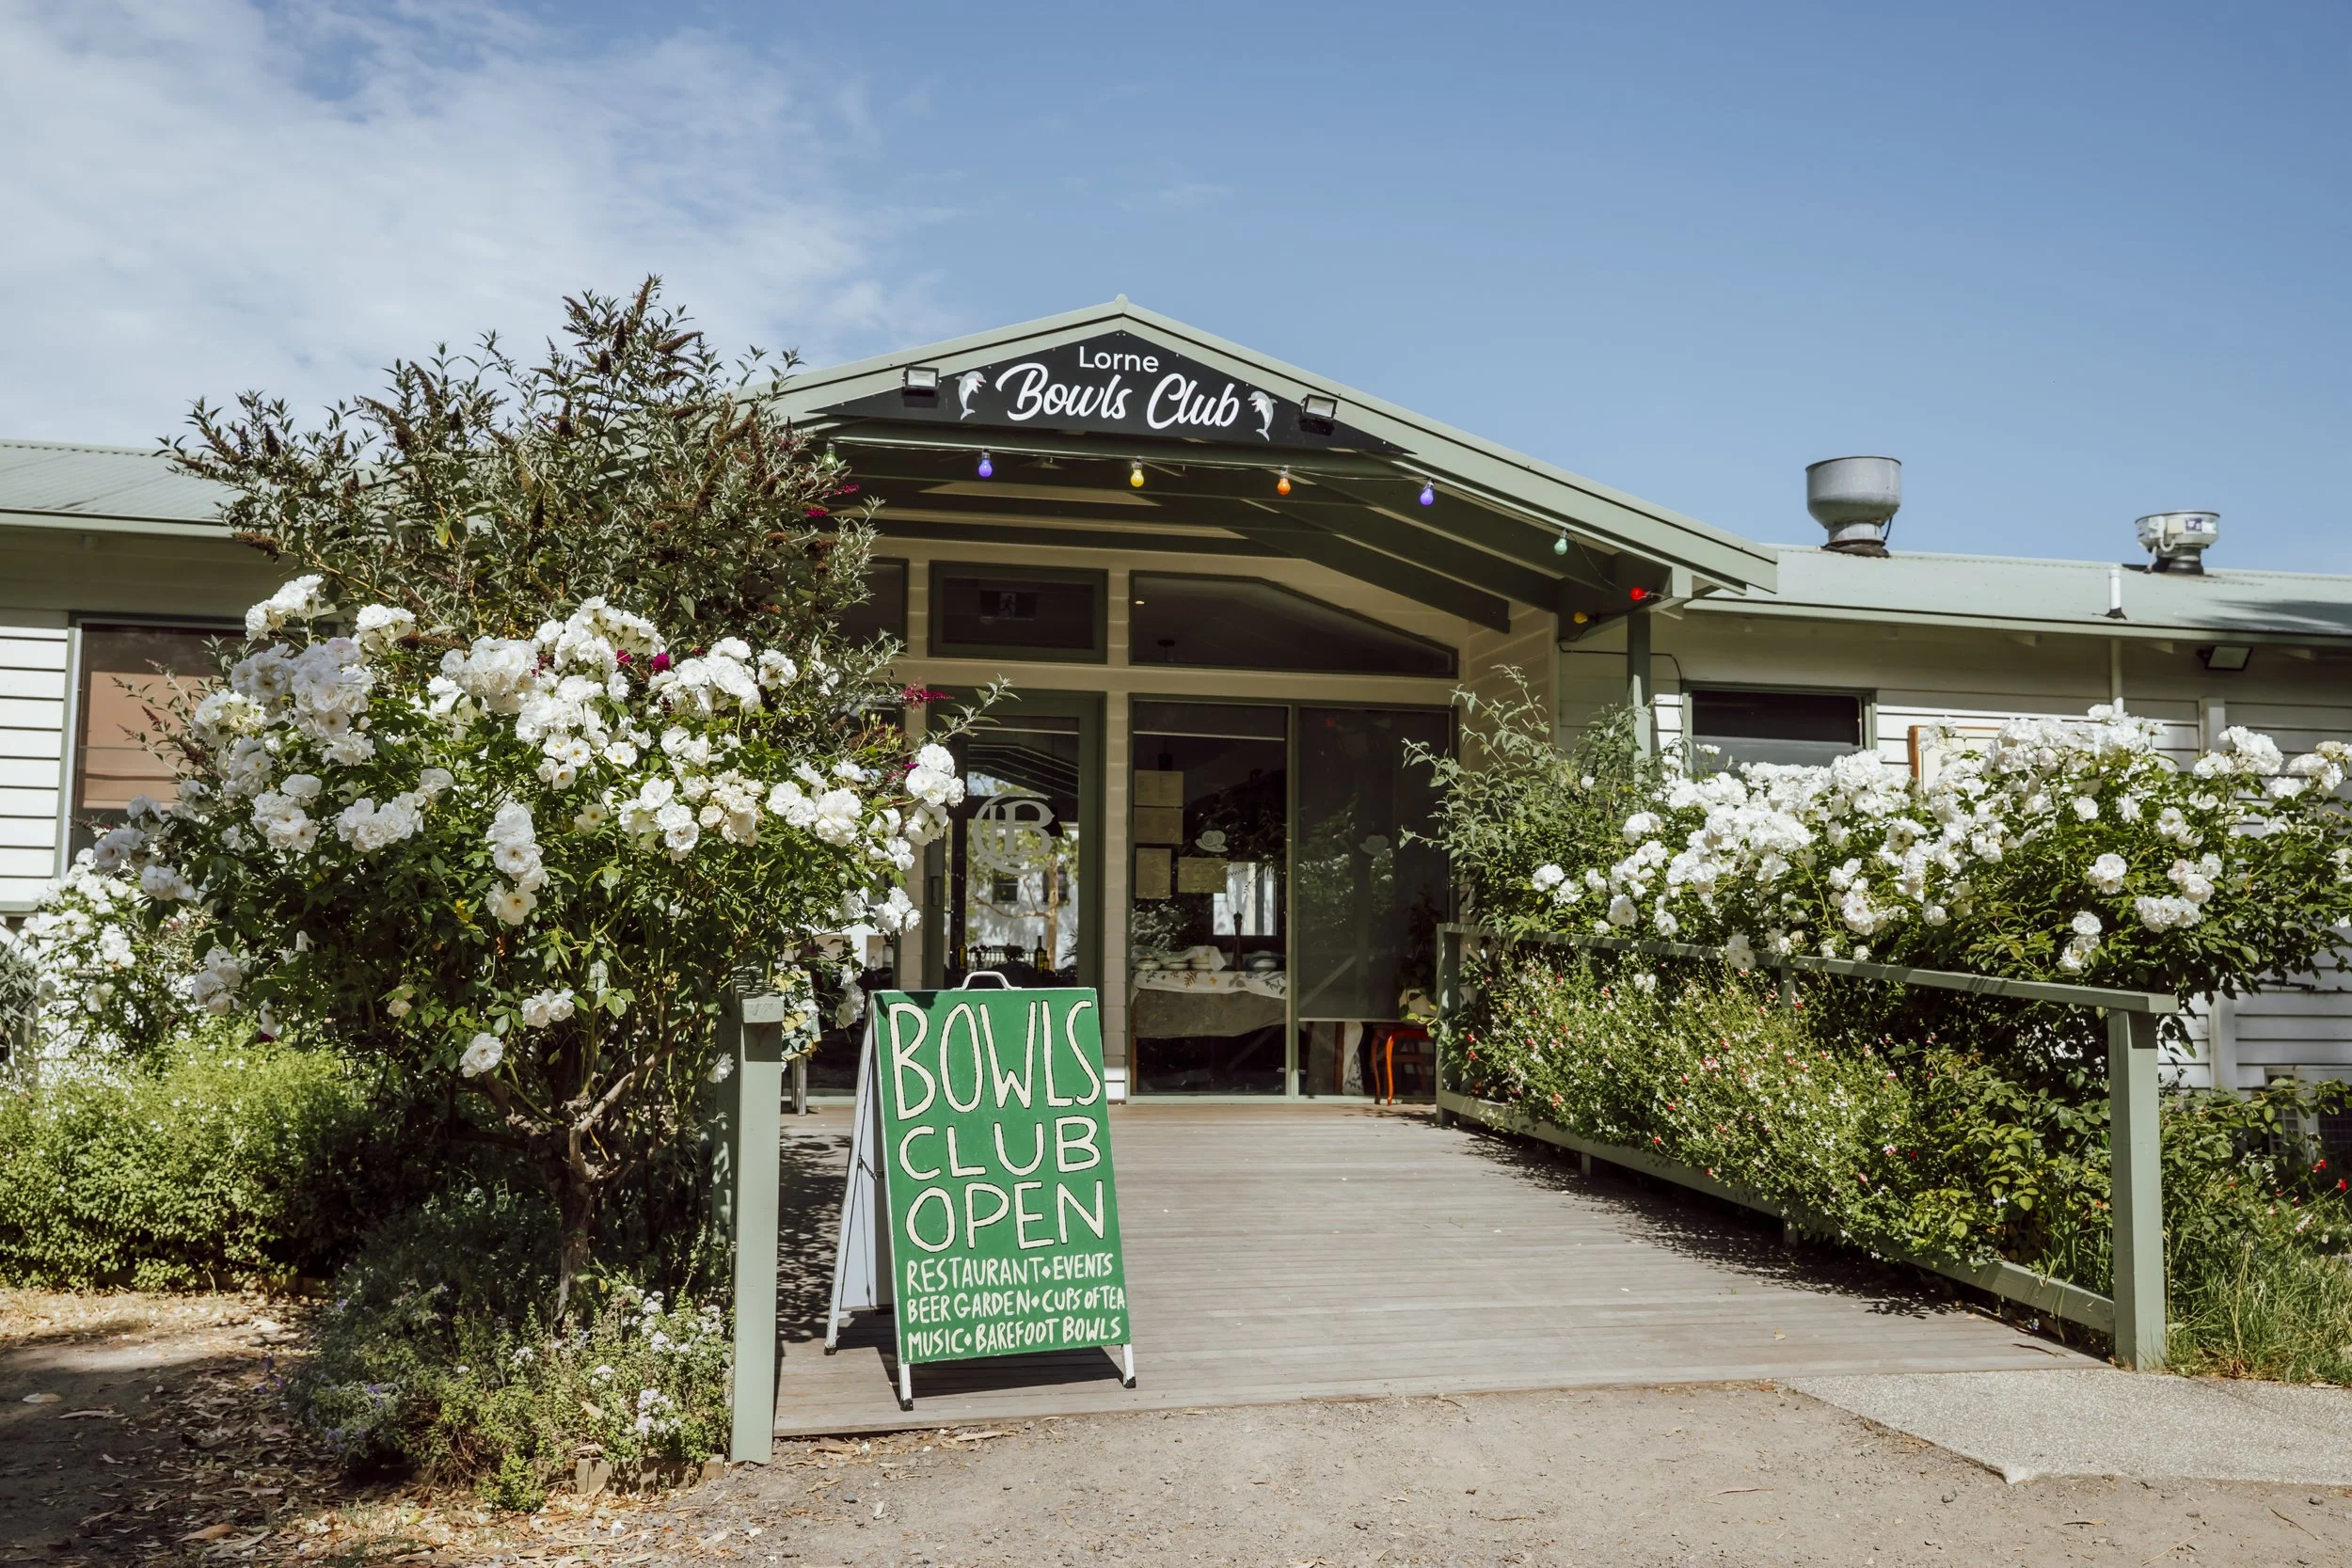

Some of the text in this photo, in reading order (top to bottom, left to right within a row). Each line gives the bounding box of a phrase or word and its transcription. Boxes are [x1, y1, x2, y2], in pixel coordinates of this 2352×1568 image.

[1079, 346, 1159, 372] Lorne
[994, 362, 1240, 429] Bowls Club
[889, 1001, 1101, 1120] BOWLS
[898, 1116, 1101, 1180] CLUB
[905, 1180, 1104, 1253] OPEN
[907, 1253, 1113, 1295] RESTAURANT EVENTS
[907, 1295, 951, 1323] BEER
[954, 1290, 1030, 1318] GARDEN
[1042, 1288, 1083, 1312] CUPS
[908, 1316, 1121, 1360] MUSIC BAREFOOT BOWLS
